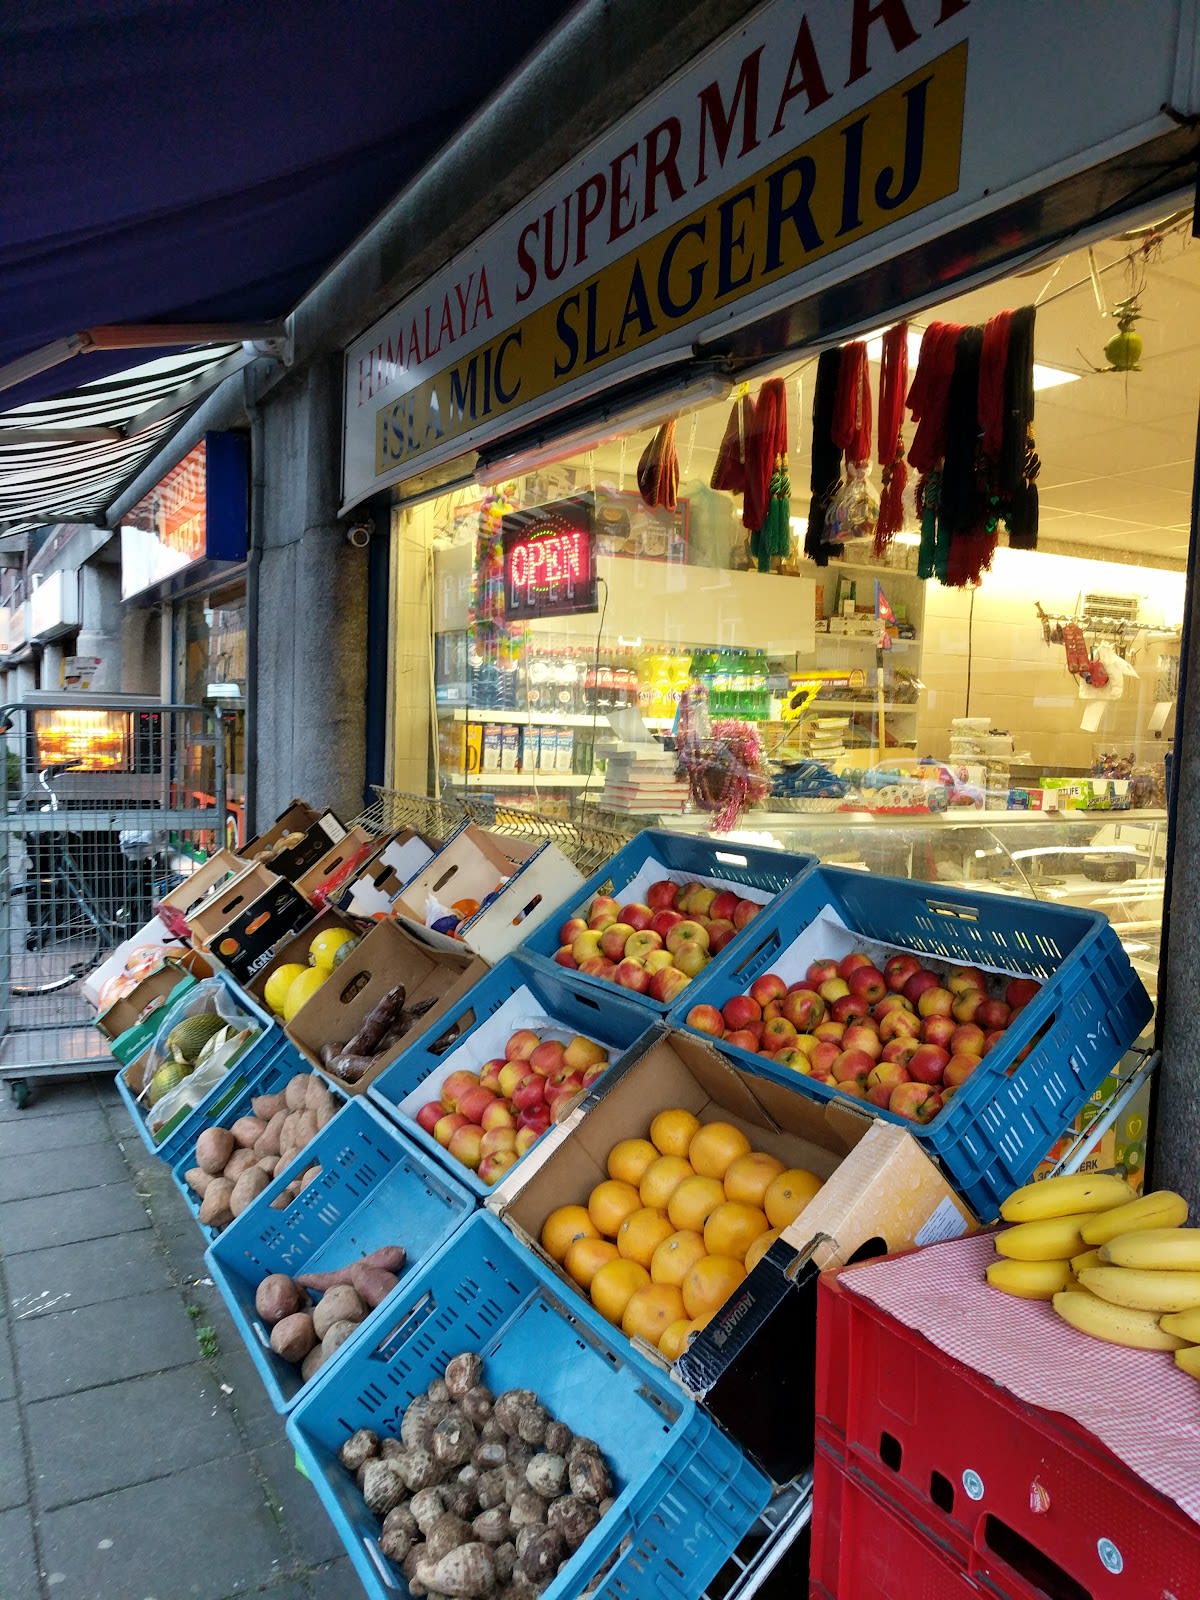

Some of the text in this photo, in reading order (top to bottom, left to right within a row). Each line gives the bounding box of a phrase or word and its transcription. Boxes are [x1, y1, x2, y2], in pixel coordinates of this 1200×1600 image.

[358, 0, 971, 408] HIMALAYA SUPERMAR
[381, 74, 935, 467] ISLAMIC SLAGERIJ
[511, 533, 580, 586] OPEN
[722, 1290, 756, 1337] JAGUAR
